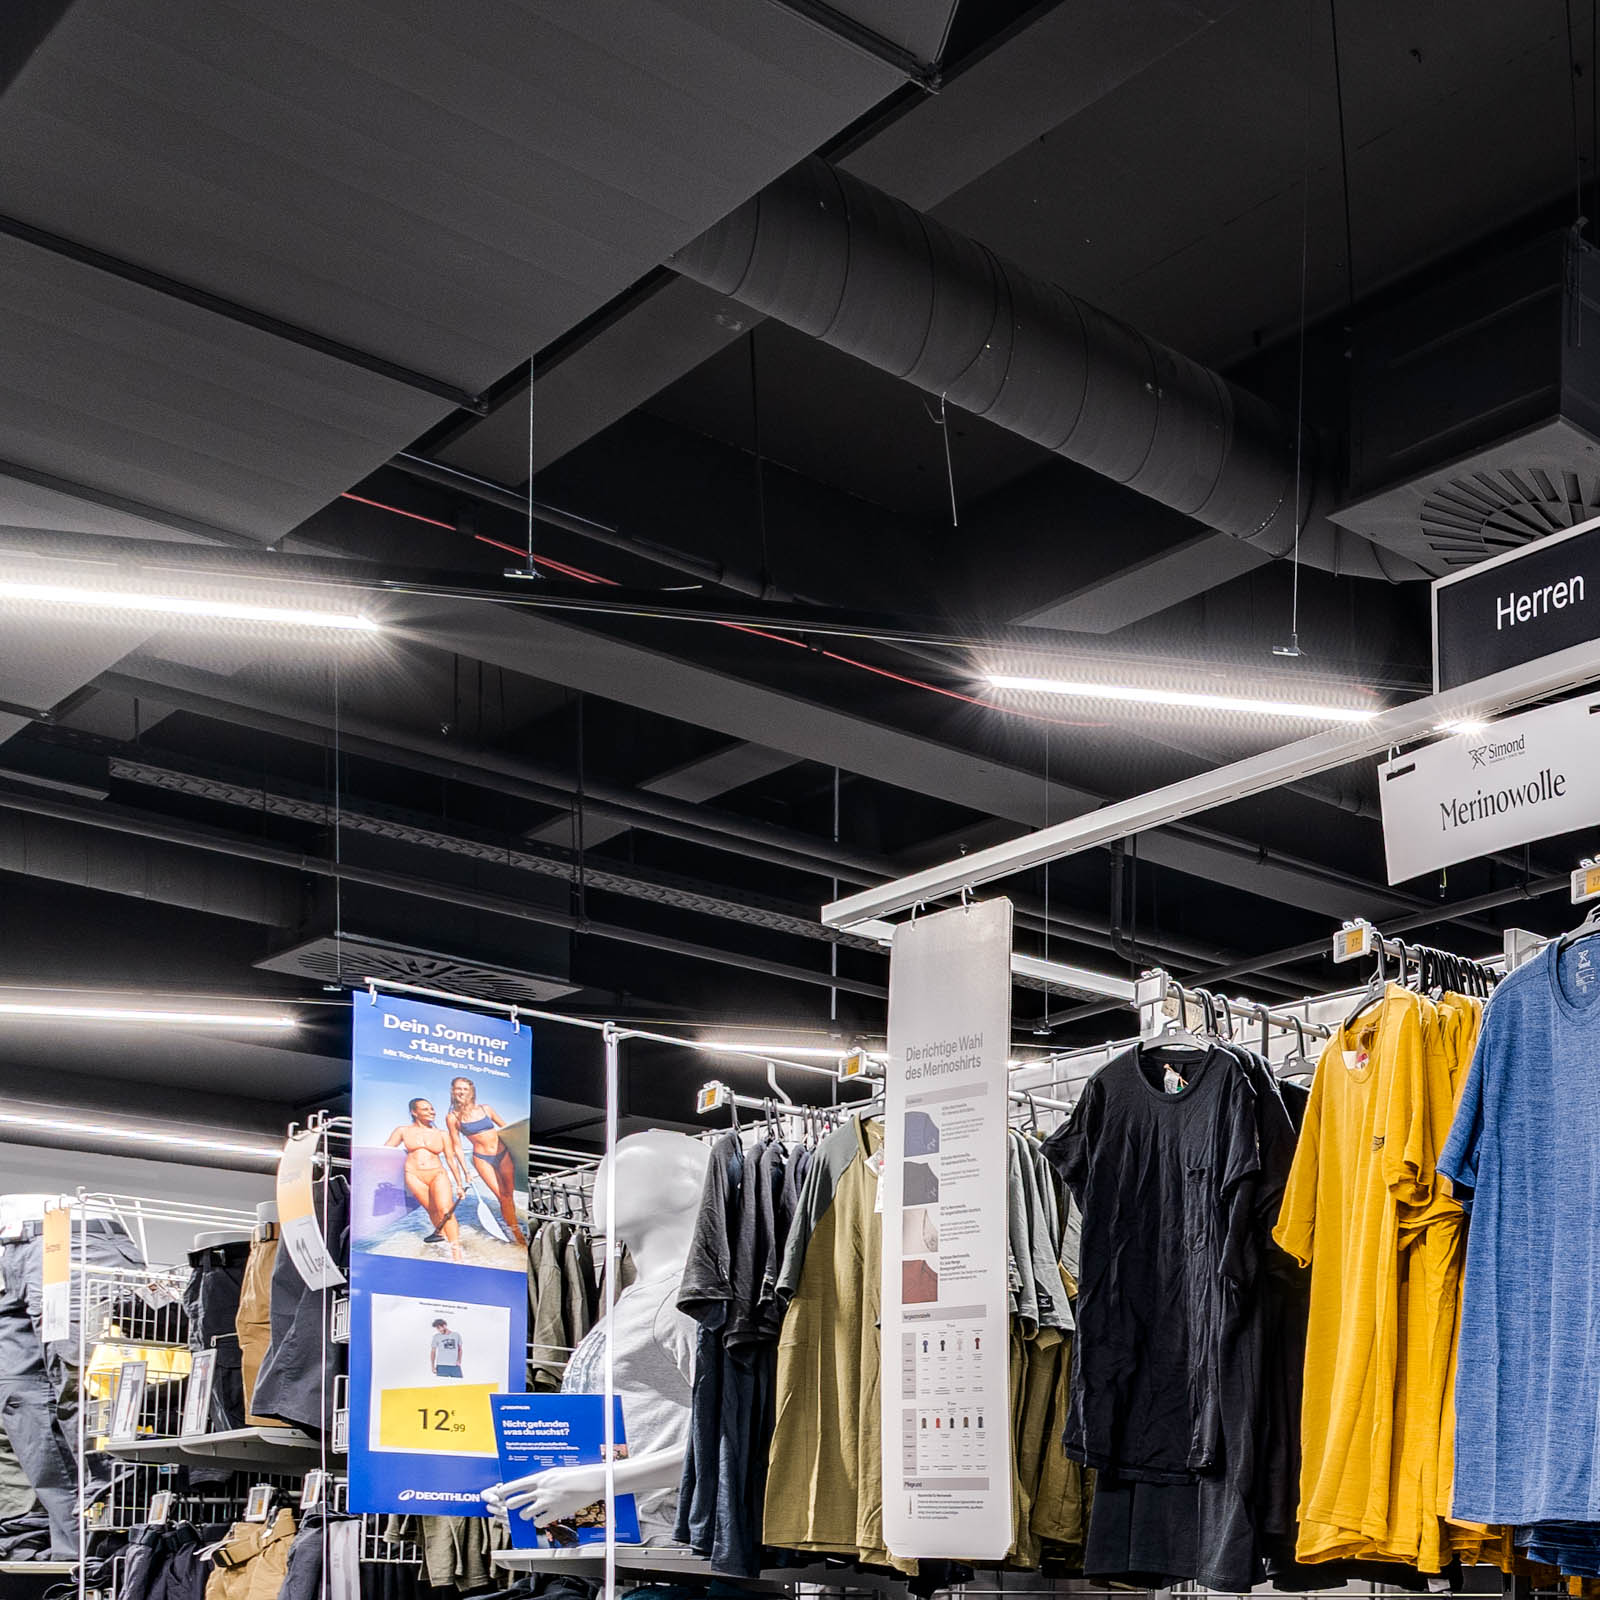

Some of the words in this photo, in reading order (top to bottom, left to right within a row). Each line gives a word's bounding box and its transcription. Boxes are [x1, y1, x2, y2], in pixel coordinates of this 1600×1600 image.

[1496, 575, 1584, 630] Herren
[1488, 733, 1525, 759] Simond
[1440, 768, 1566, 831] Merinowolle
[384, 1014, 429, 1036] Dein
[432, 1024, 509, 1051] Sommer
[409, 1039, 475, 1061] startet
[478, 1049, 511, 1068] hier
[906, 1047, 921, 1062] Die
[922, 1040, 957, 1059] richtige
[959, 1032, 983, 1052] Wahl
[905, 1067, 921, 1080] des
[923, 1055, 981, 1078] Merinoshirts
[502, 1420, 526, 1428] Nicht
[527, 1420, 569, 1430] gefunden
[523, 1428, 535, 1436] du
[535, 1428, 570, 1436] suchst?
[416, 1491, 480, 1503] DECATHLON
